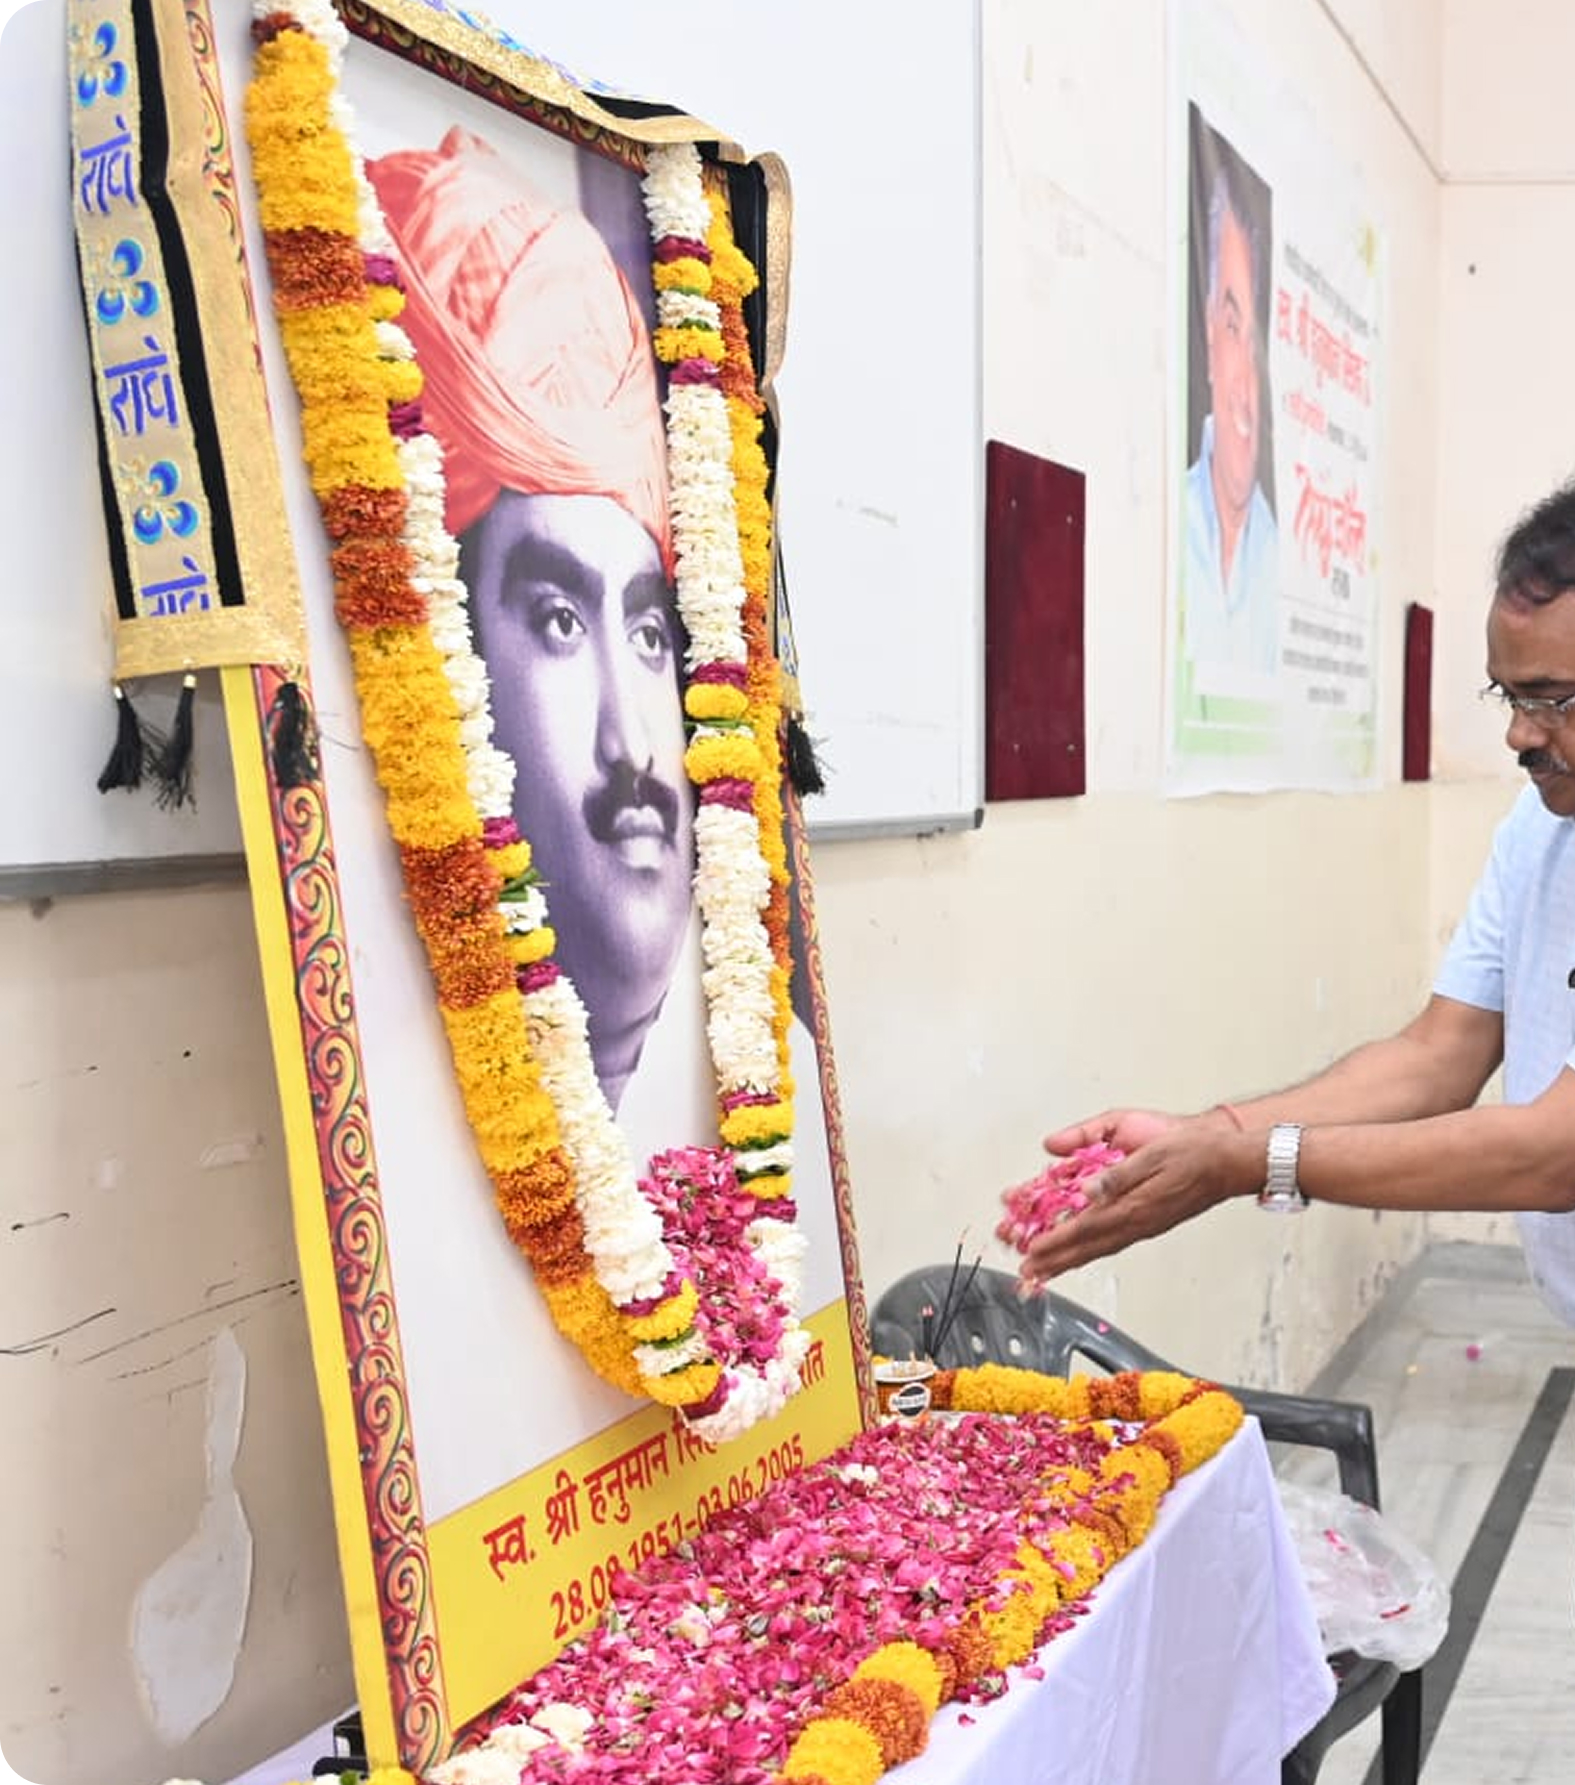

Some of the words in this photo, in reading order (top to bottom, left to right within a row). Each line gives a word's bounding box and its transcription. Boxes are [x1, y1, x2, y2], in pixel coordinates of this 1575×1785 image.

[483, 1514, 536, 1582] स्व.
[545, 1468, 580, 1546] श्री
[583, 1431, 670, 1525] हनुमान
[550, 1432, 804, 1640] 28.081951-0306.2005
